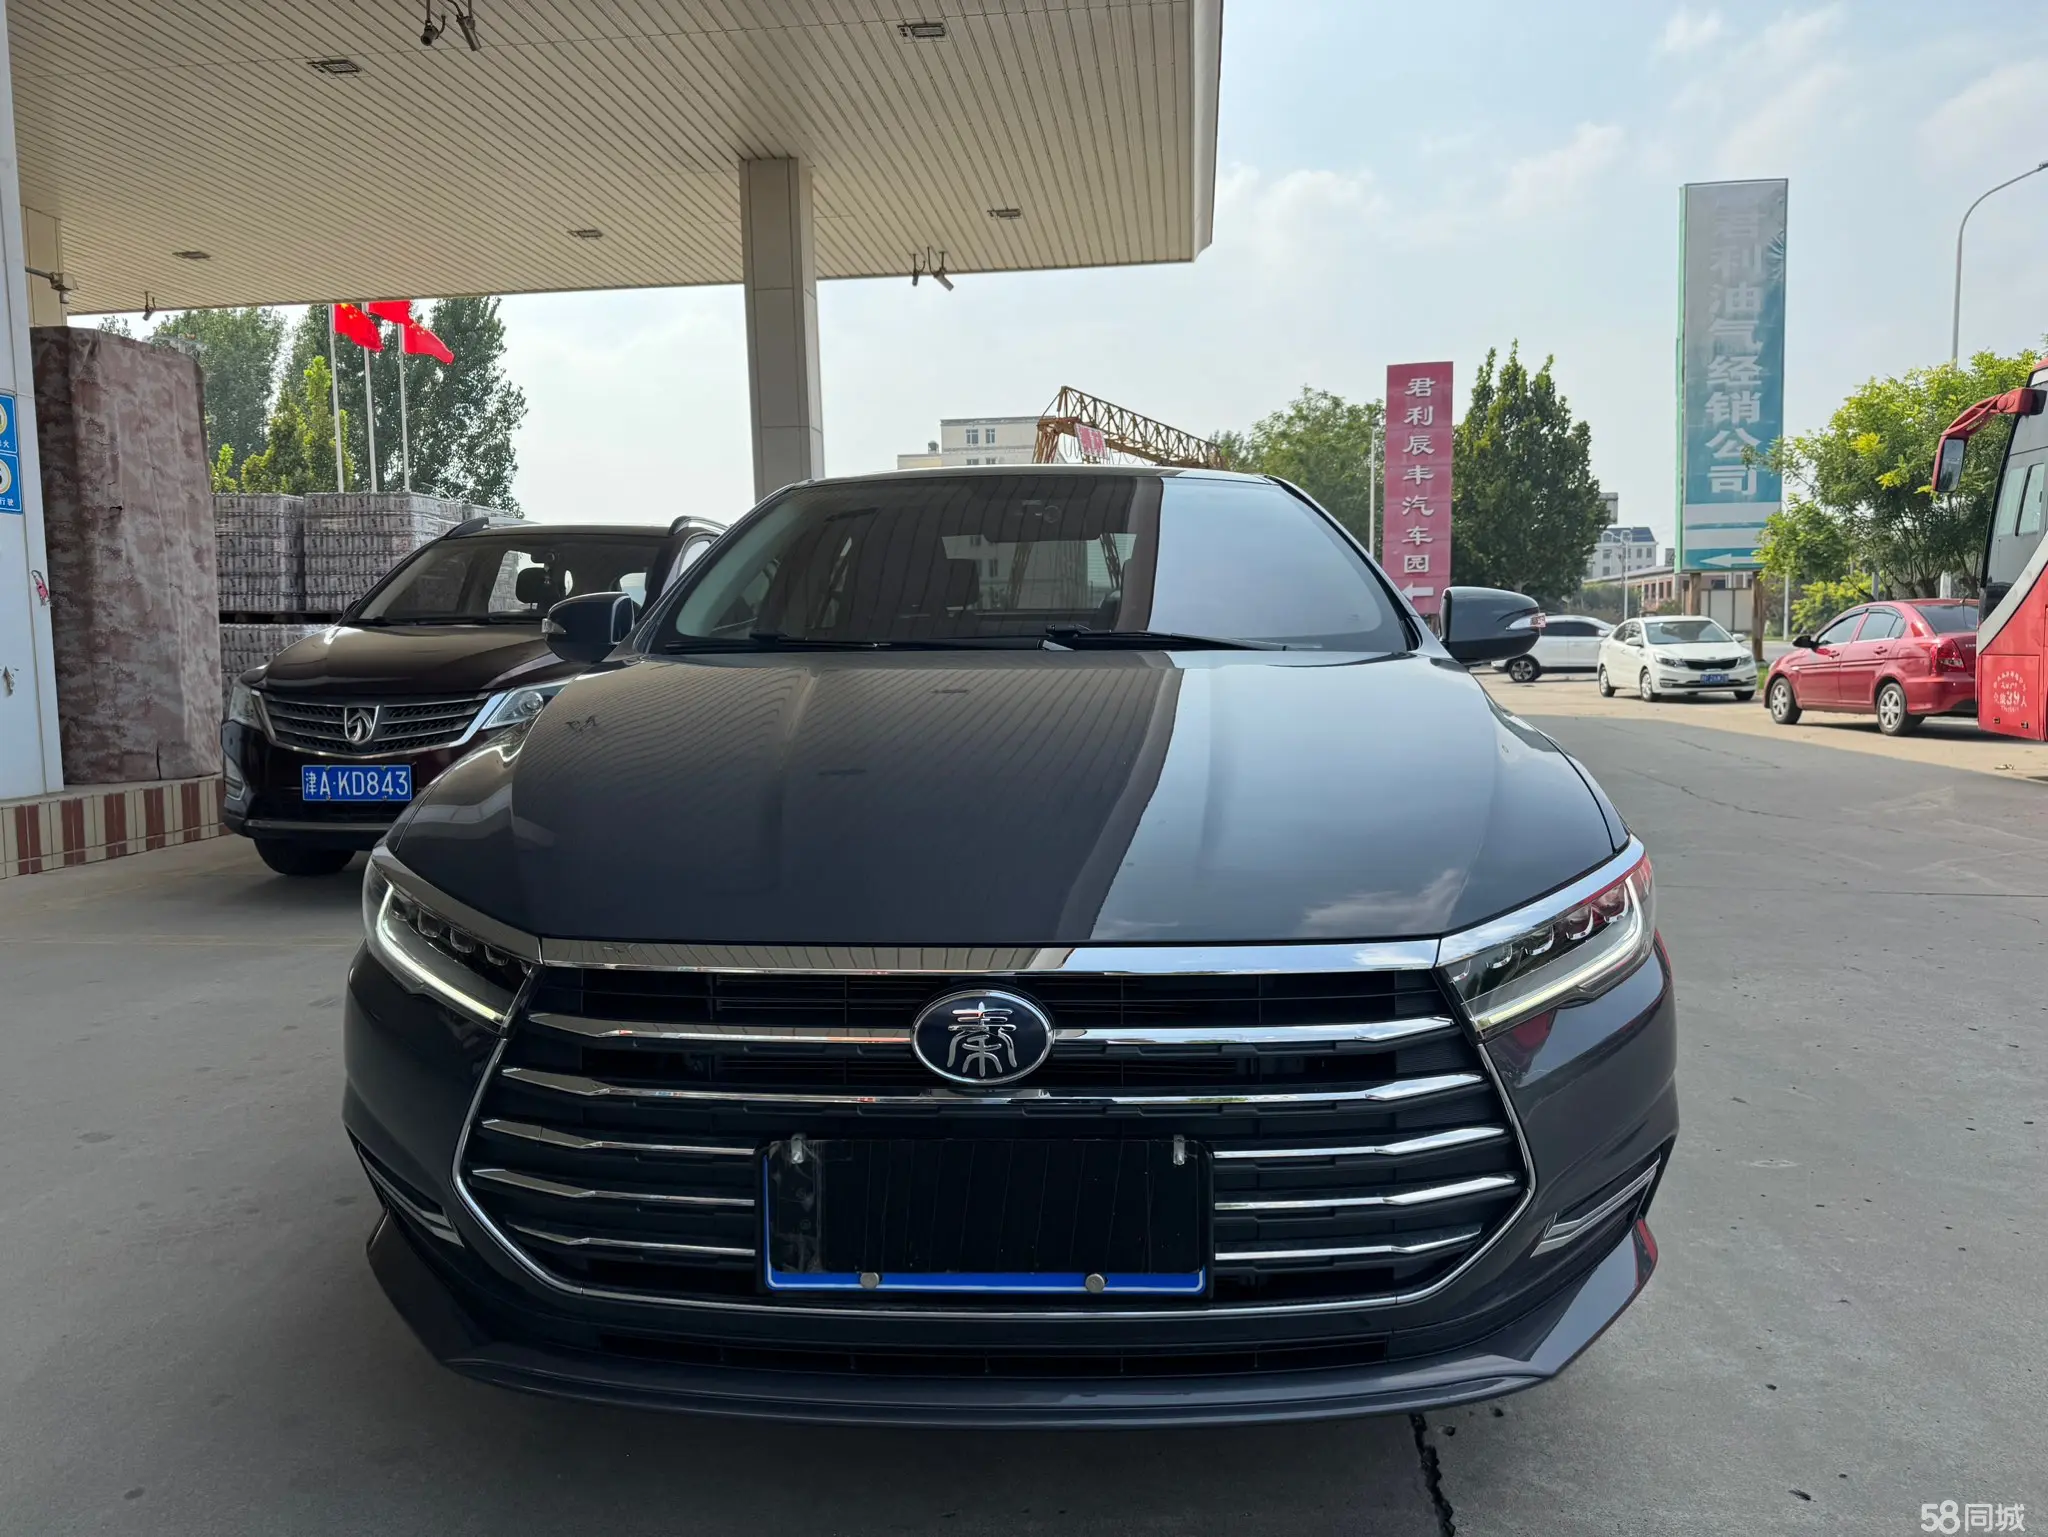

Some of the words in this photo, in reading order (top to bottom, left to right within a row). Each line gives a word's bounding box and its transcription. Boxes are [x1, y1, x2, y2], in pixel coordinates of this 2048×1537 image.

[1401, 377, 1436, 573] 君利辰丰汽车园
